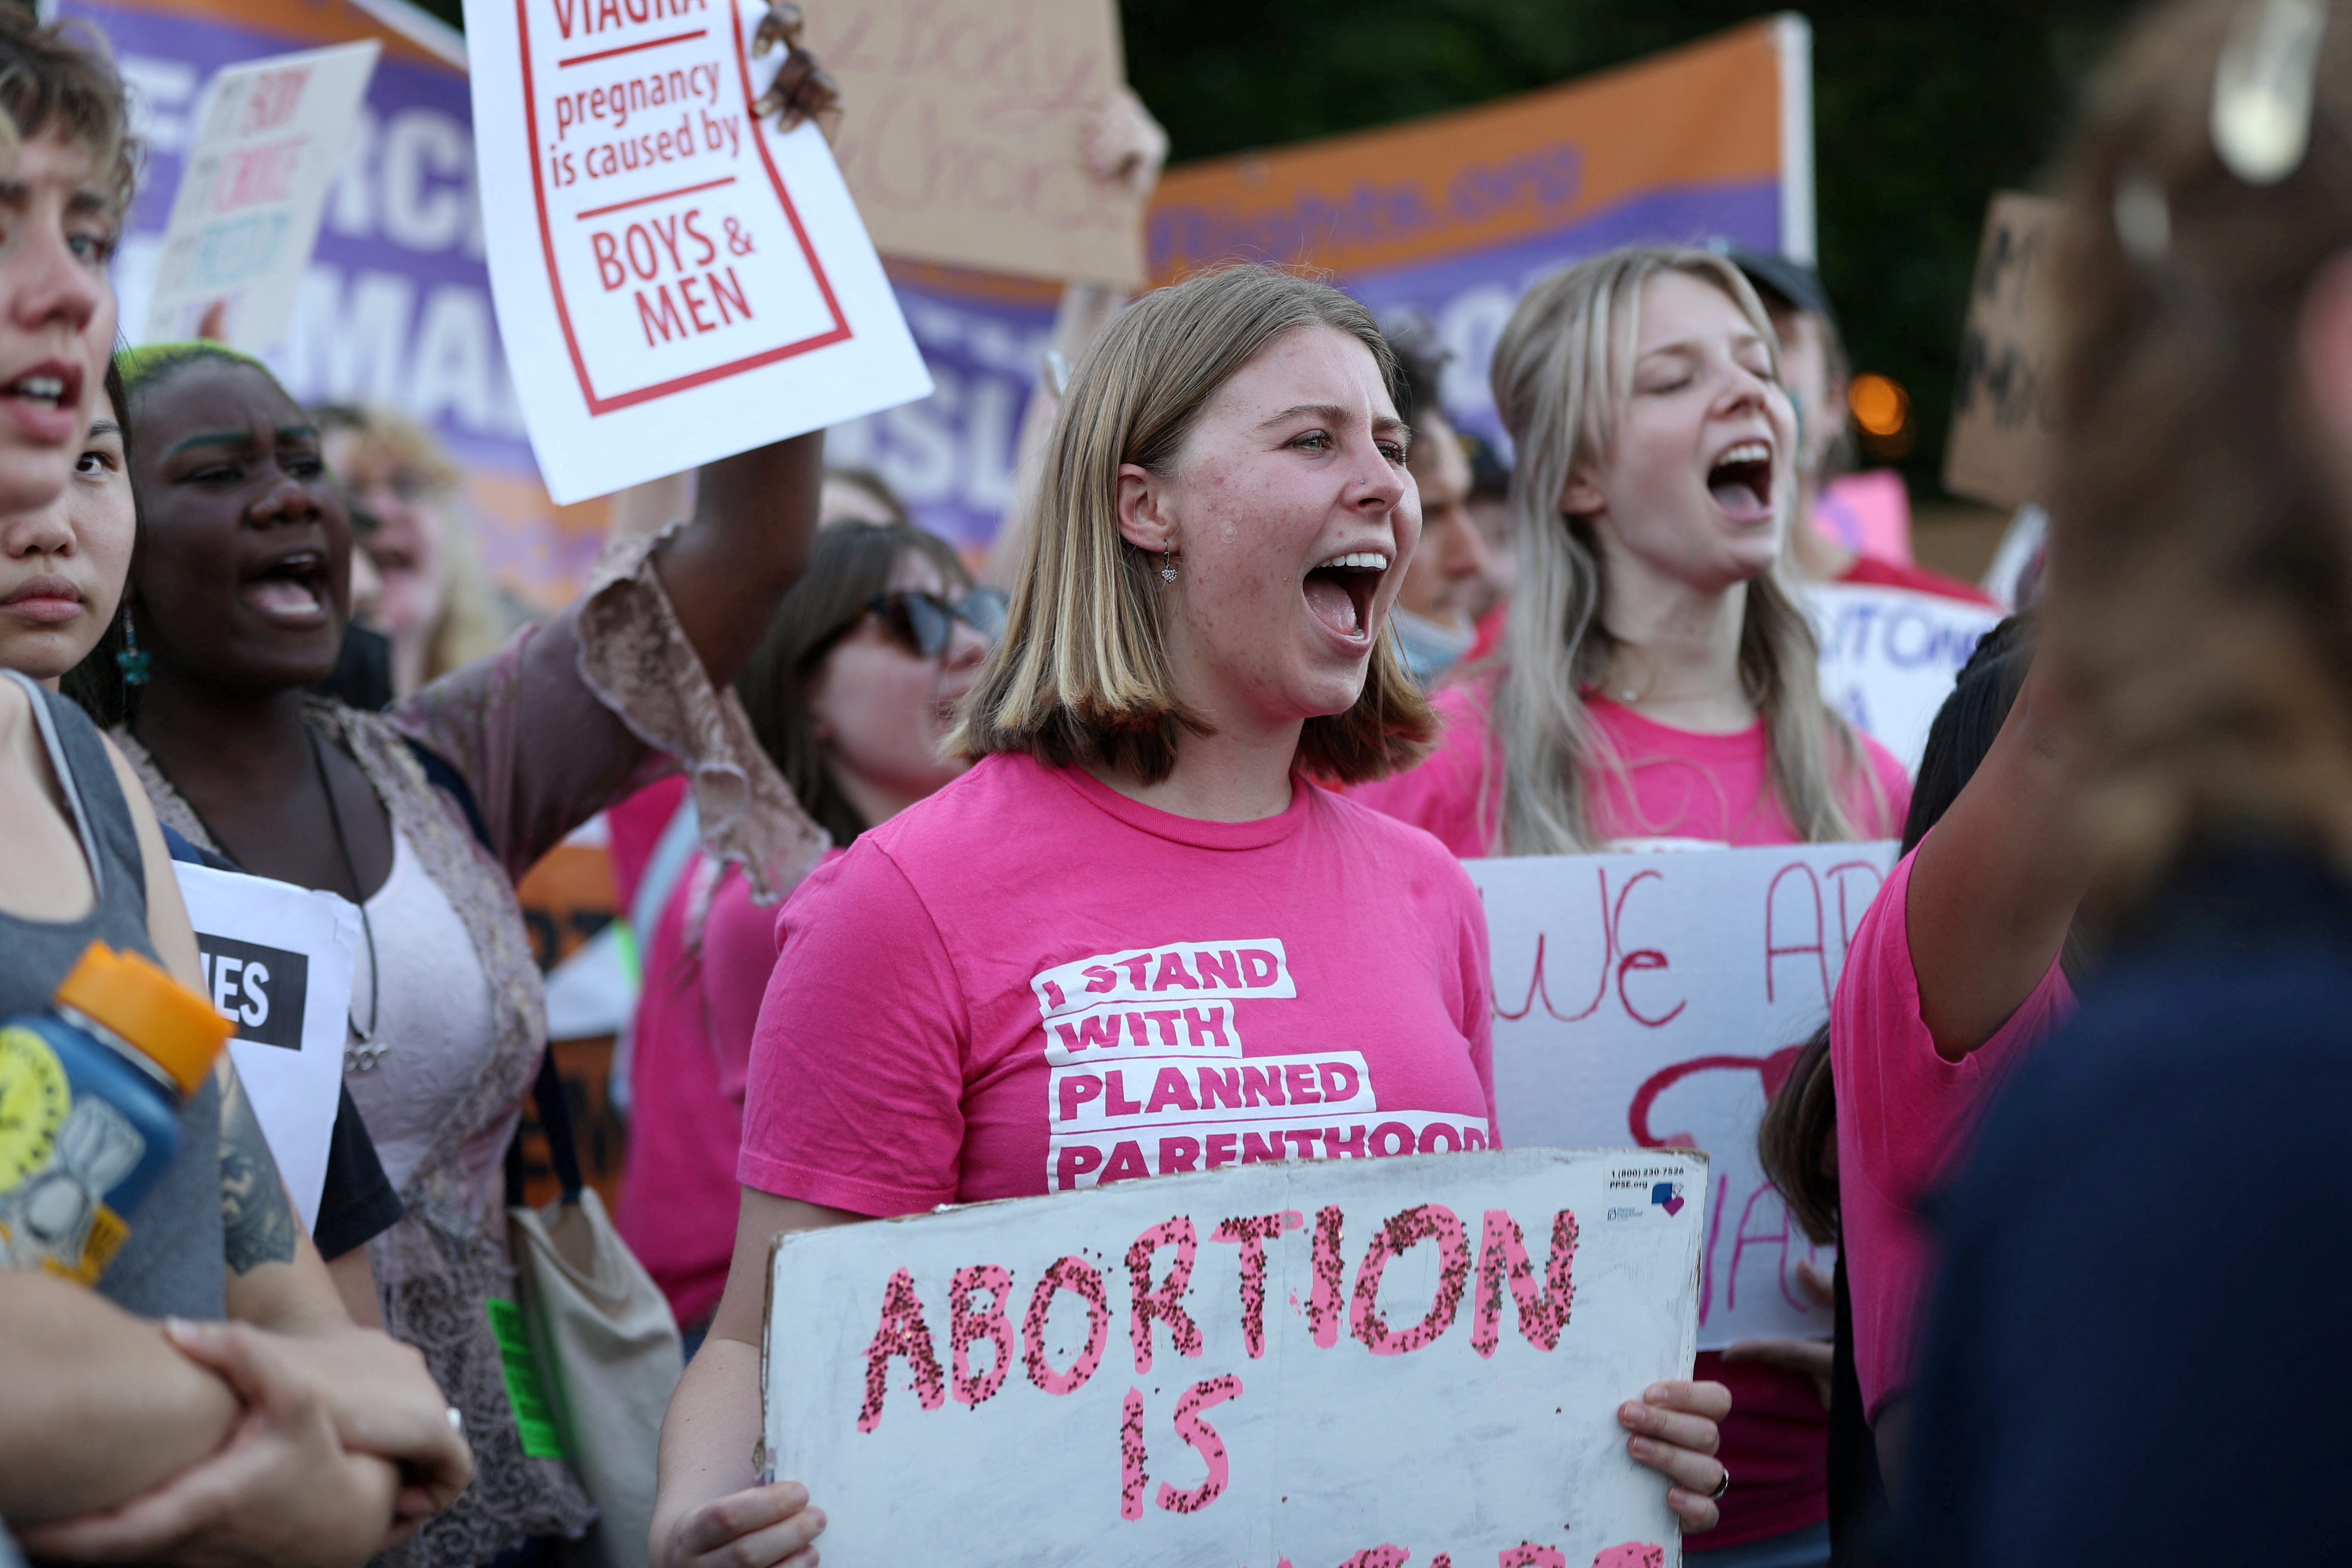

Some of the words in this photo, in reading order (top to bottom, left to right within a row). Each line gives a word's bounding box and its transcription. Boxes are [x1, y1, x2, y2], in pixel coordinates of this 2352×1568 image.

[552, 0, 707, 39] VIA
[556, 62, 719, 141] pregnancy
[551, 144, 576, 188] is
[585, 113, 695, 179] caused
[701, 109, 739, 158] by
[591, 209, 717, 292] BOYS
[723, 217, 756, 256] &
[634, 266, 753, 346] MEN
[1041, 980, 1066, 1011] I
[1081, 948, 1278, 992] STAND
[1054, 1006, 1226, 1054] WITH
[1058, 1062, 1360, 1121] PLANNED
[1057, 1121, 1486, 1191] PARENTHOOD
[1618, 1168, 1641, 1179] (800)
[858, 1204, 1580, 1433] ABORTION
[1121, 1374, 1243, 1521] IS
